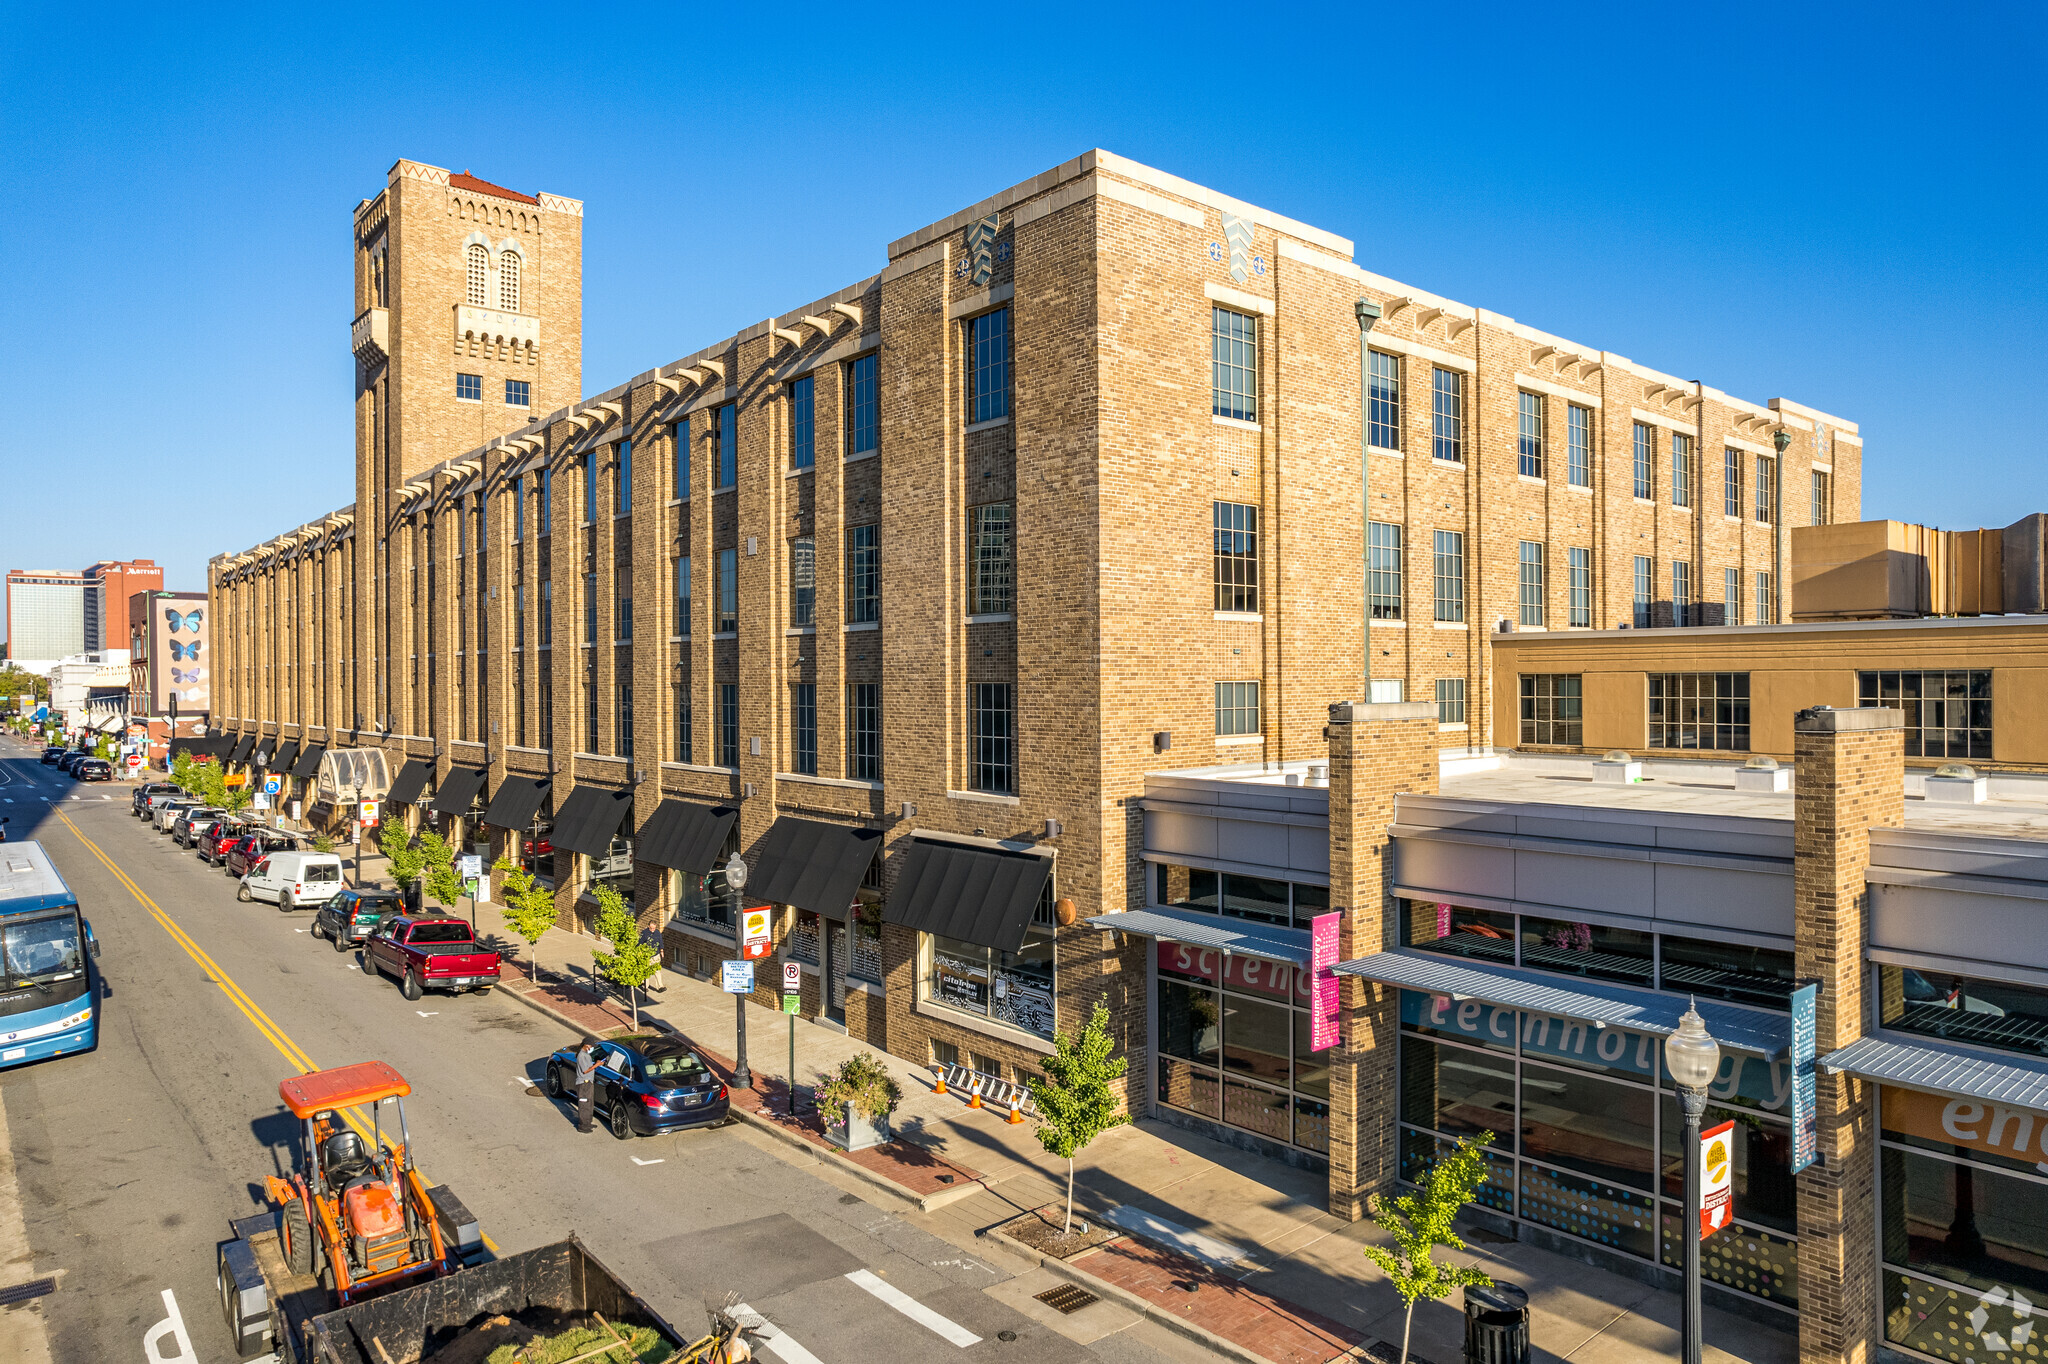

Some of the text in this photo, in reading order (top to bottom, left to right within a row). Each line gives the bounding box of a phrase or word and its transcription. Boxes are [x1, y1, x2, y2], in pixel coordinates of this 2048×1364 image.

[1177, 944, 1311, 996] scienc
[1429, 996, 1792, 1110] technolgy
[1709, 1146, 1723, 1158] RIVER
[1707, 1153, 1725, 1167] MARKET
[1705, 1195, 1729, 1210] DISTRICT
